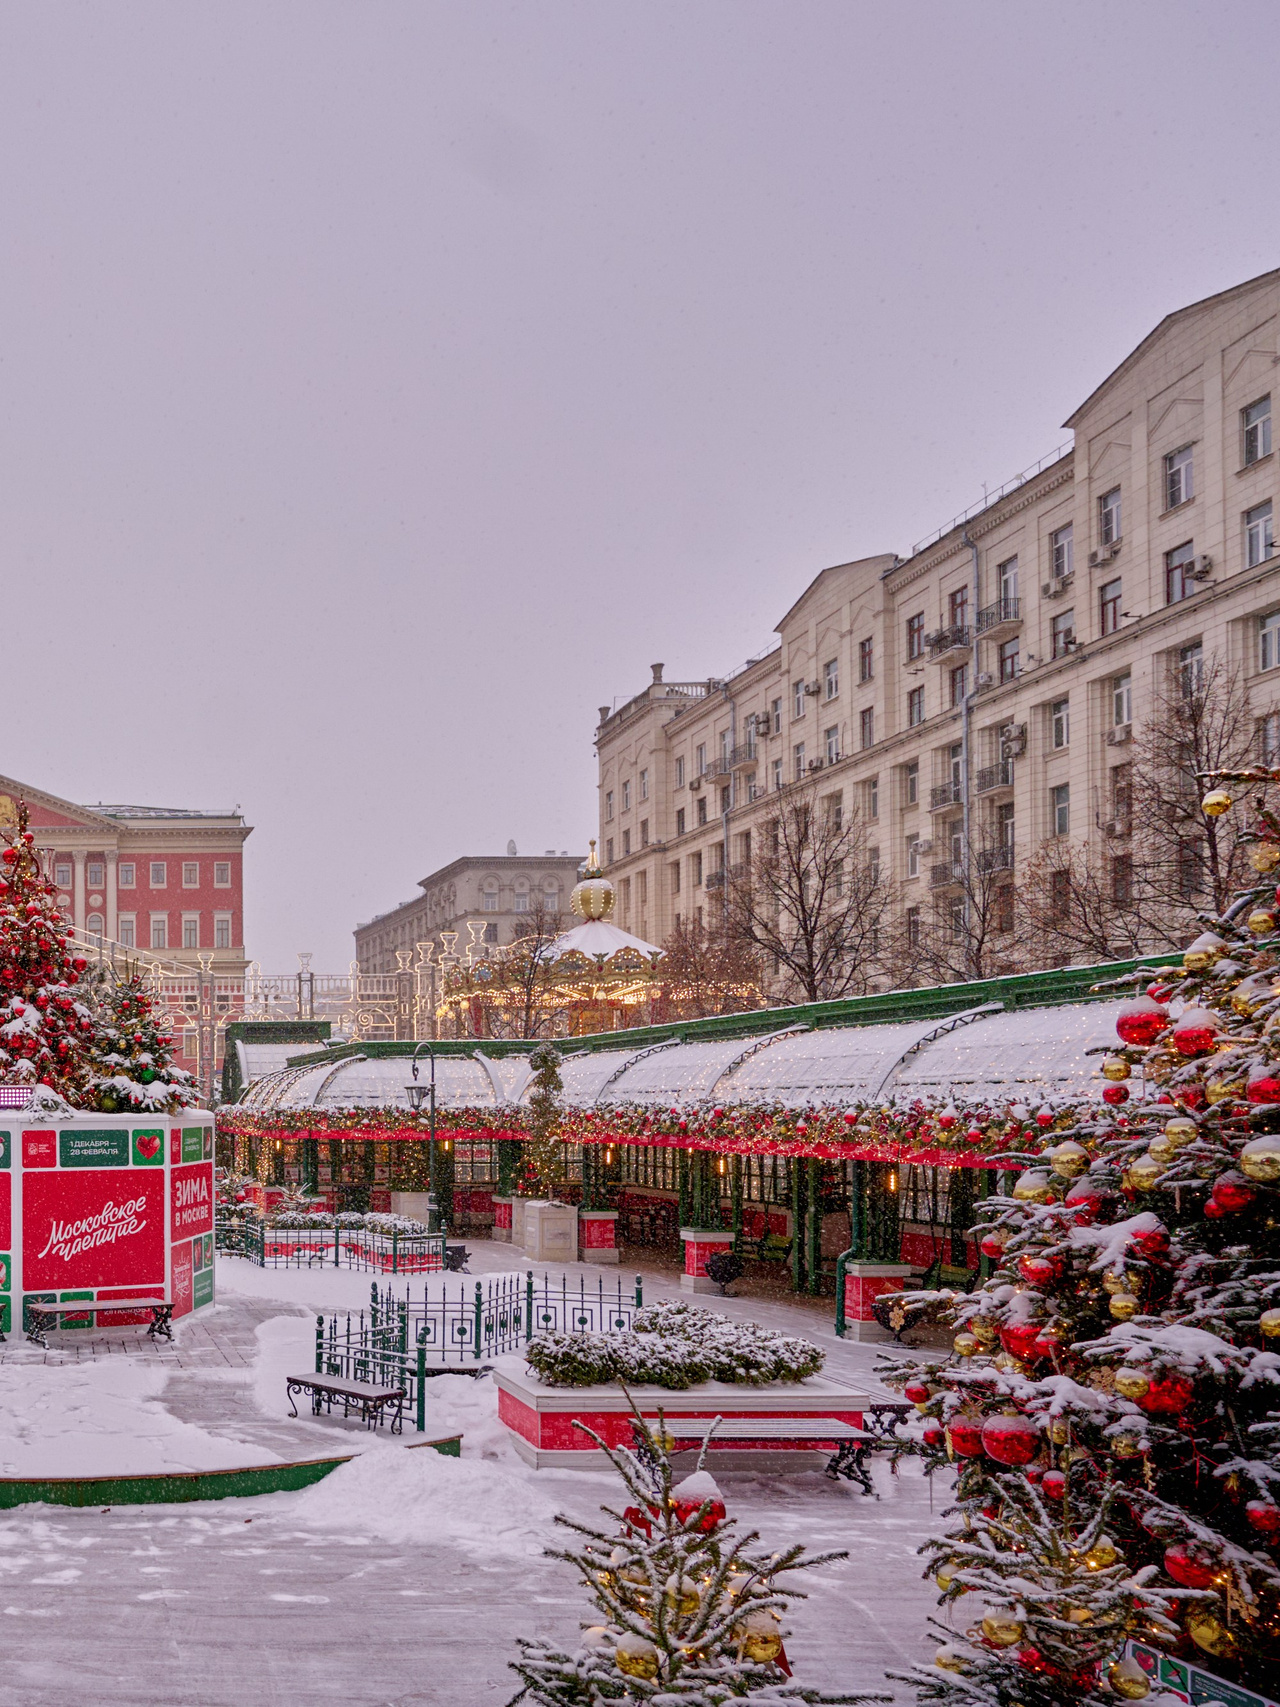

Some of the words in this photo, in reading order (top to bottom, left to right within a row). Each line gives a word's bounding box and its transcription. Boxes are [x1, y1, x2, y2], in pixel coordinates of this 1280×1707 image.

[74, 1140, 109, 1148] ДЕКАБРЯ
[175, 1176, 209, 1208] ЗИМА
[37, 1196, 147, 1258] Московское
[175, 1212, 181, 1227] В
[181, 1204, 209, 1225] МОСКВЕ
[51, 1215, 147, 1261] чаепитие
